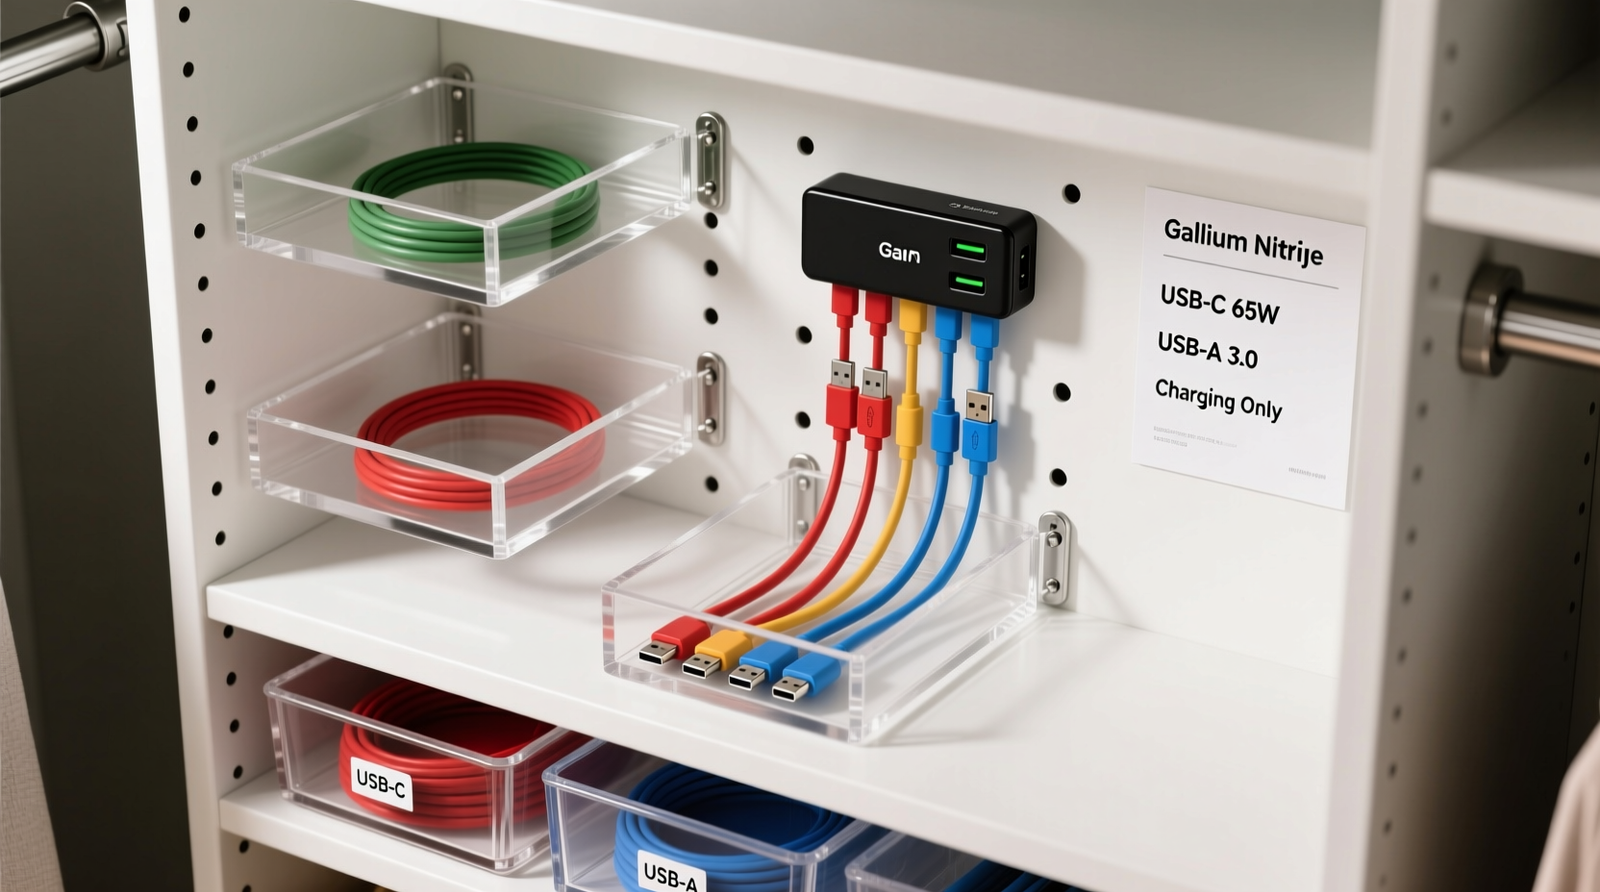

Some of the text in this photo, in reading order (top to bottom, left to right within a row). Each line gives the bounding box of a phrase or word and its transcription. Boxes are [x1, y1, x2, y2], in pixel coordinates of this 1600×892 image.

[1164, 218, 1248, 252] Gallium
[1161, 283, 1280, 325] USB-C 65W
[1158, 331, 1258, 369] USB-A 3.0
[1155, 378, 1283, 423] Charging Only
[357, 768, 406, 799] USB-C
[644, 862, 698, 892] USB-A
